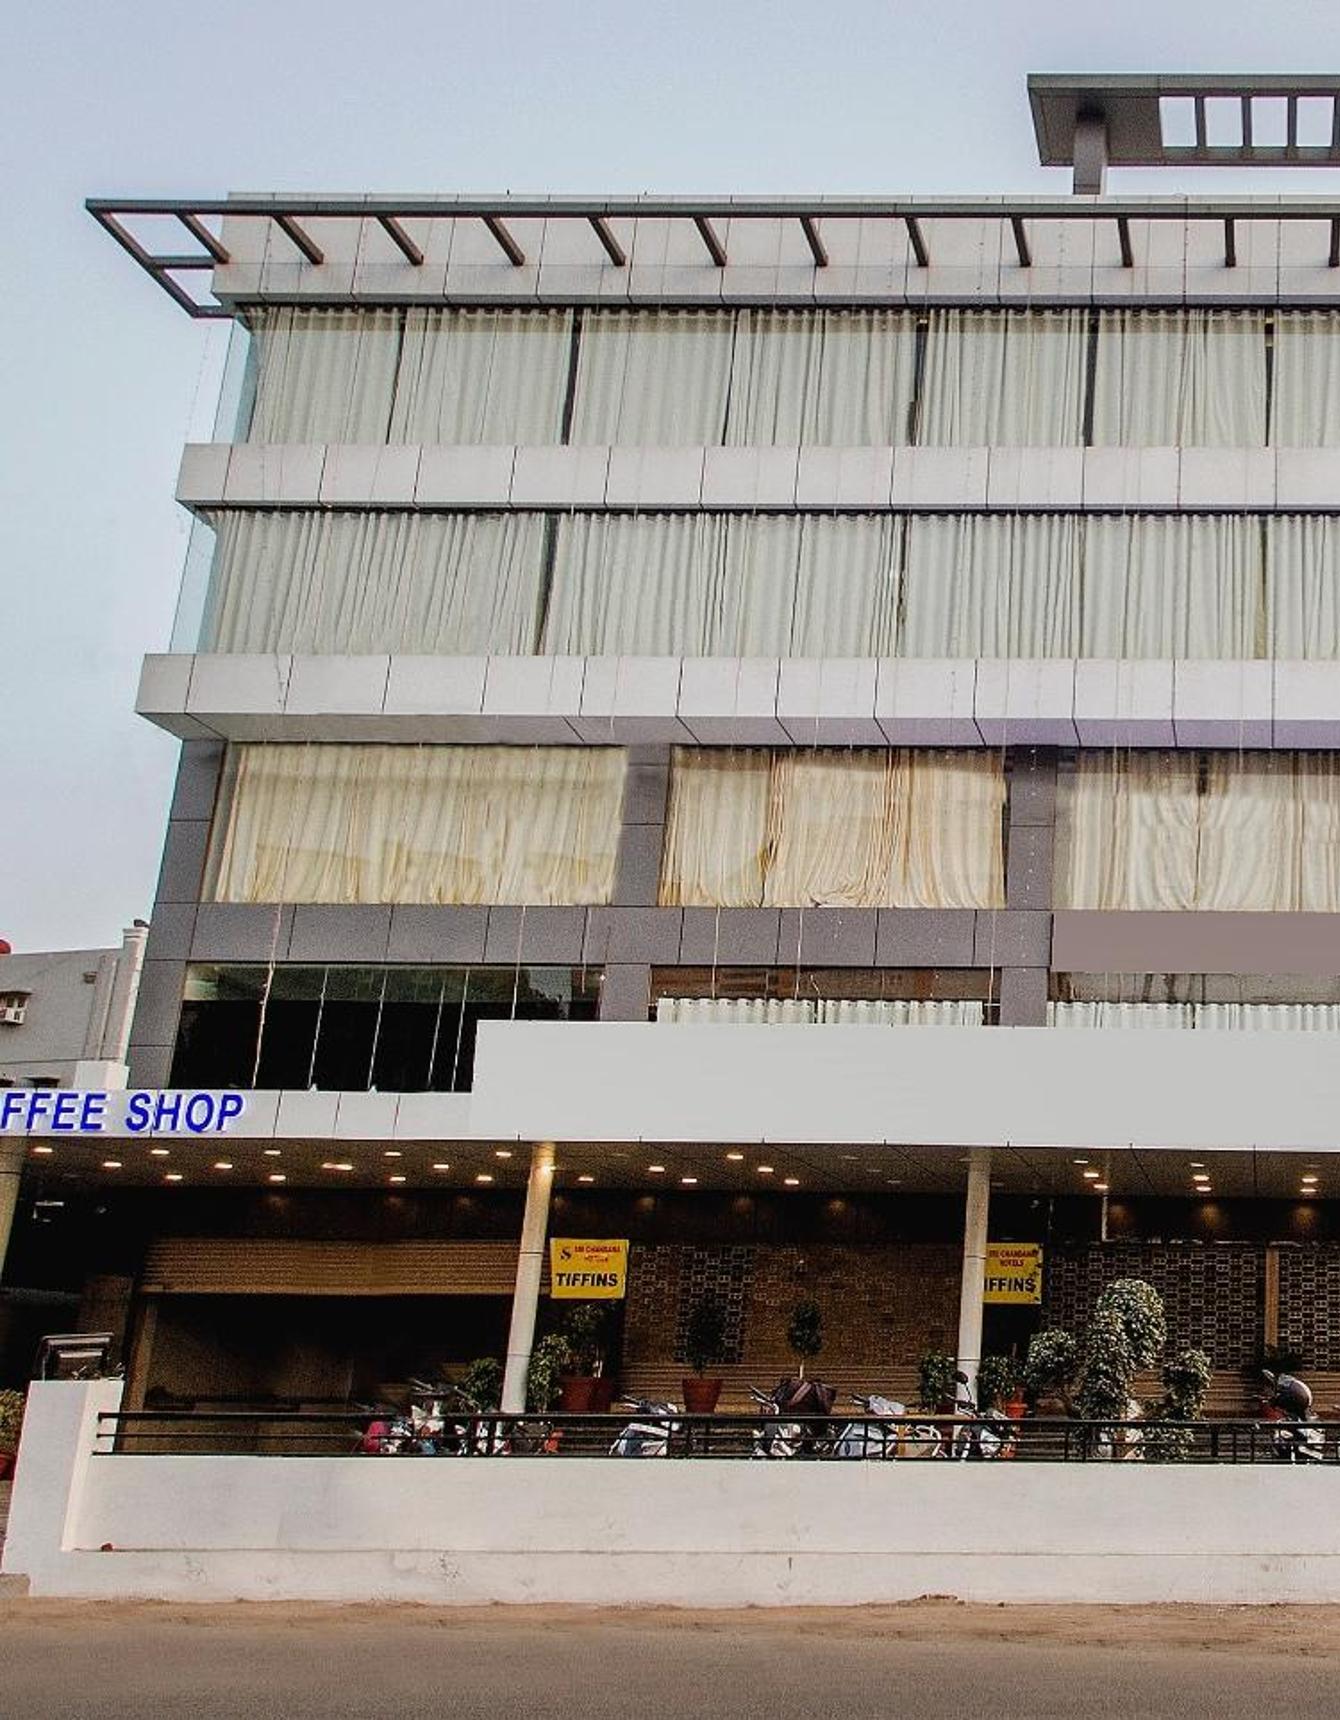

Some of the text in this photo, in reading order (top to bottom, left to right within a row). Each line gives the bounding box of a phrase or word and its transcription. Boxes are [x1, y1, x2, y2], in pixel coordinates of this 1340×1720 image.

[1, 1092, 244, 1132] FFEE SHOP
[556, 1272, 618, 1287] TIFFINS
[984, 1277, 1036, 1293] IFFINS
